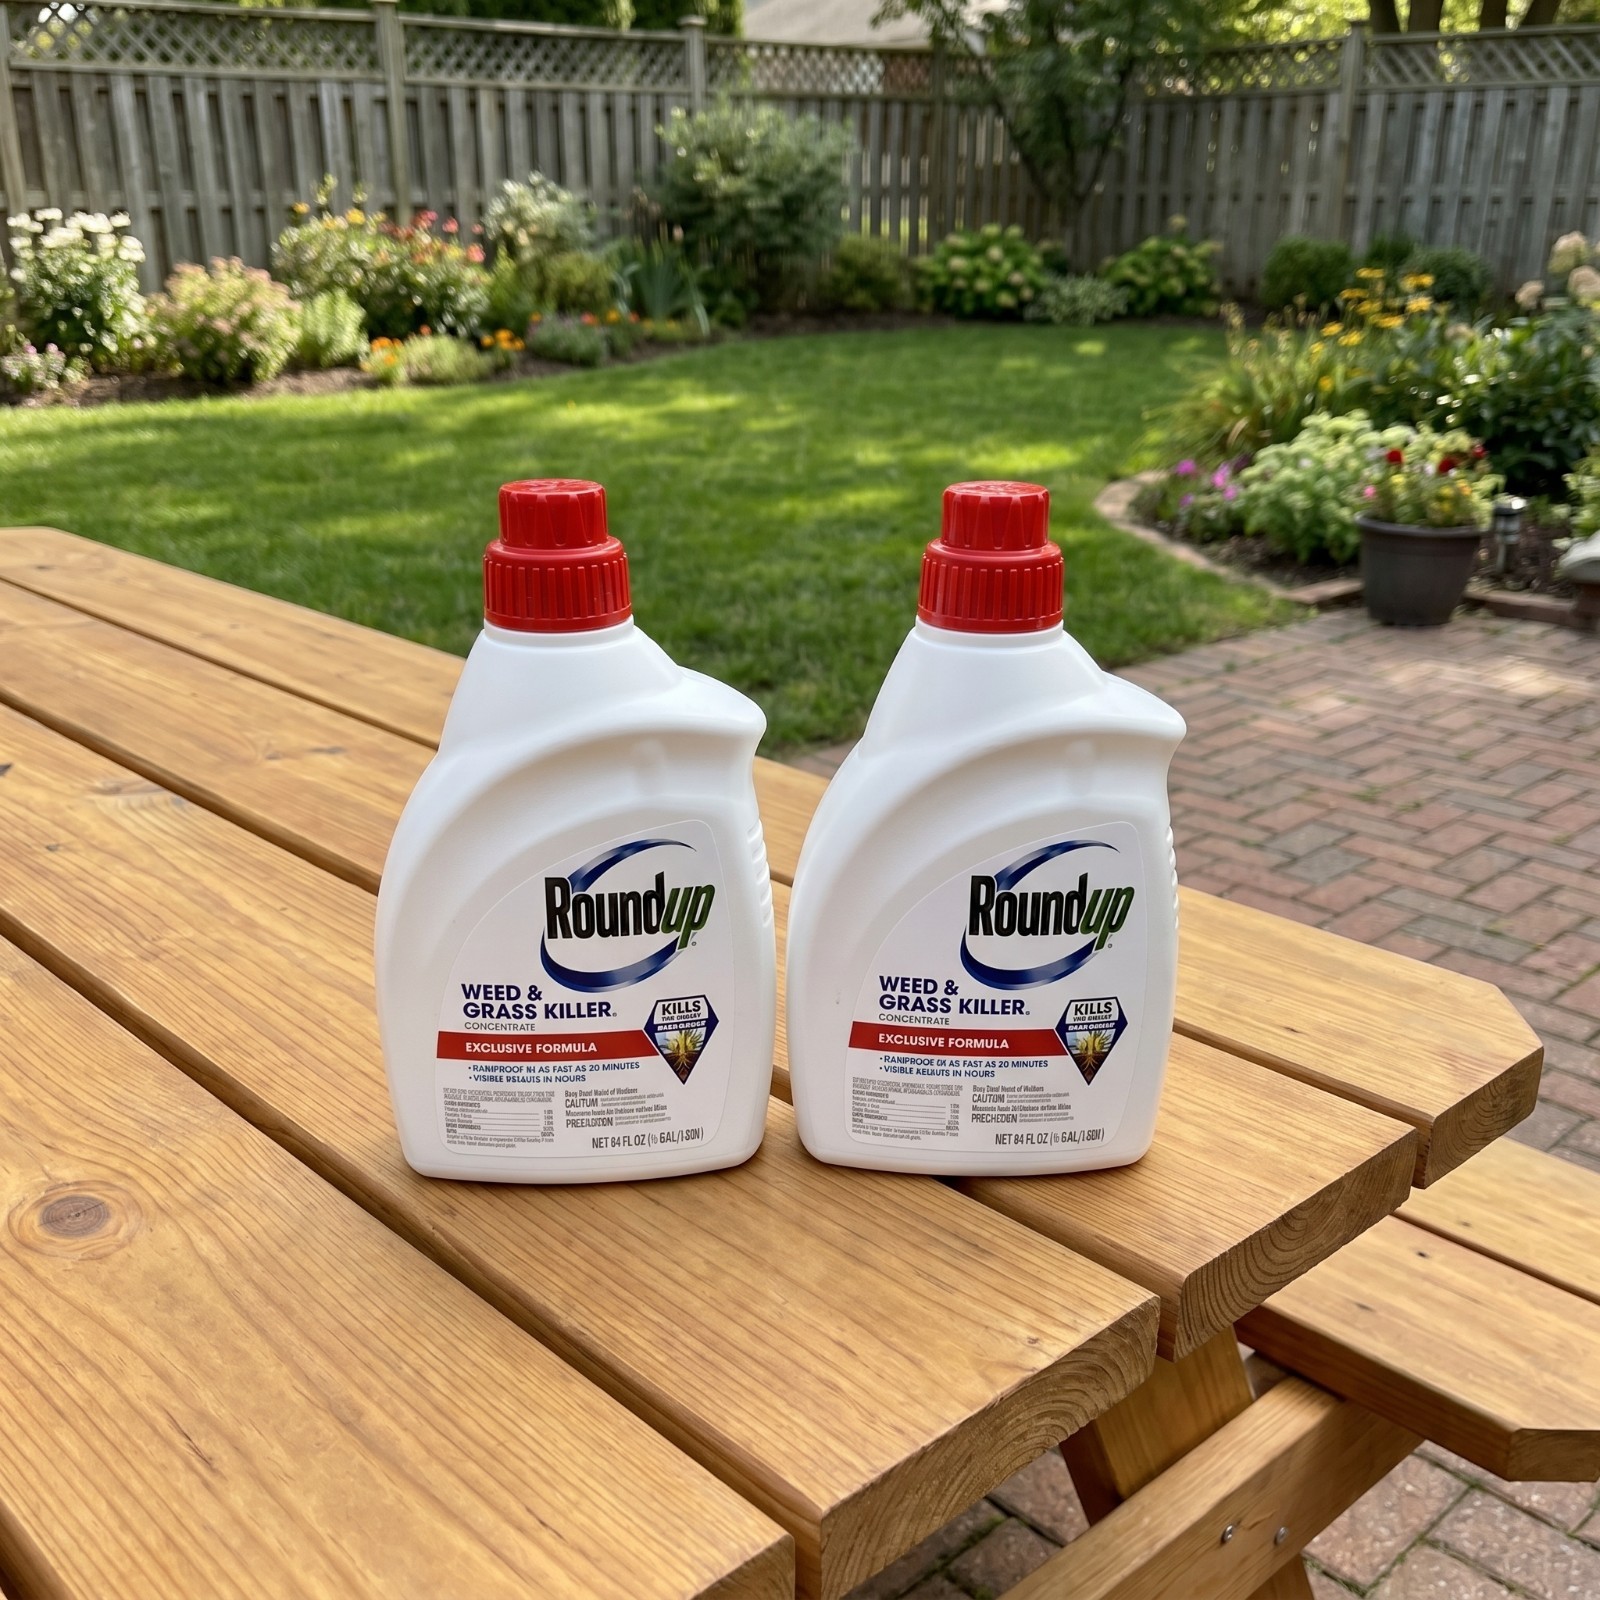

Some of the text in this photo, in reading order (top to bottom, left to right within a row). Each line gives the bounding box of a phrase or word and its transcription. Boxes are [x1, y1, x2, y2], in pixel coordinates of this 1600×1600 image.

[544, 871, 716, 950] Roundup
[968, 872, 1135, 951] Roundup
[461, 983, 543, 1001] WEED &
[879, 975, 959, 996] WEED &
[463, 1001, 612, 1020] GRASS KILLER
[662, 1000, 701, 1016] KILLS
[878, 994, 1026, 1016] GRASS KILLER
[1074, 1001, 1113, 1016] KILLS
[464, 1021, 536, 1032] CONCENTRATE
[878, 1013, 950, 1026] CONCENTRATE
[465, 1042, 598, 1054] EXCLUSIVE FORMULA
[878, 1033, 1010, 1049] EXCLUSIVE FORMULA
[538, 1065, 550, 1073] AS
[552, 1064, 573, 1073] FAST
[575, 1064, 587, 1072] AS
[589, 1064, 600, 1072] 20
[602, 1061, 640, 1071] MINUTES
[883, 1065, 914, 1075] VISIBLE
[952, 1069, 962, 1077] IN
[964, 1070, 995, 1078] NOURS
[949, 1060, 960, 1068] AS
[963, 1060, 983, 1068] FAST
[984, 1060, 996, 1068] AS
[998, 1060, 1009, 1068] 20
[1011, 1060, 1049, 1068] MINUTES
[473, 1074, 504, 1083] VISIBLE
[543, 1075, 552, 1083] IN
[554, 1074, 586, 1082] NOURS
[592, 1137, 609, 1149] NET
[622, 1135, 632, 1147] FL
[634, 1134, 646, 1146] OZ
[995, 1133, 1013, 1145] NET
[1026, 1133, 1035, 1145] FL
[1037, 1133, 1049, 1144] OZ
